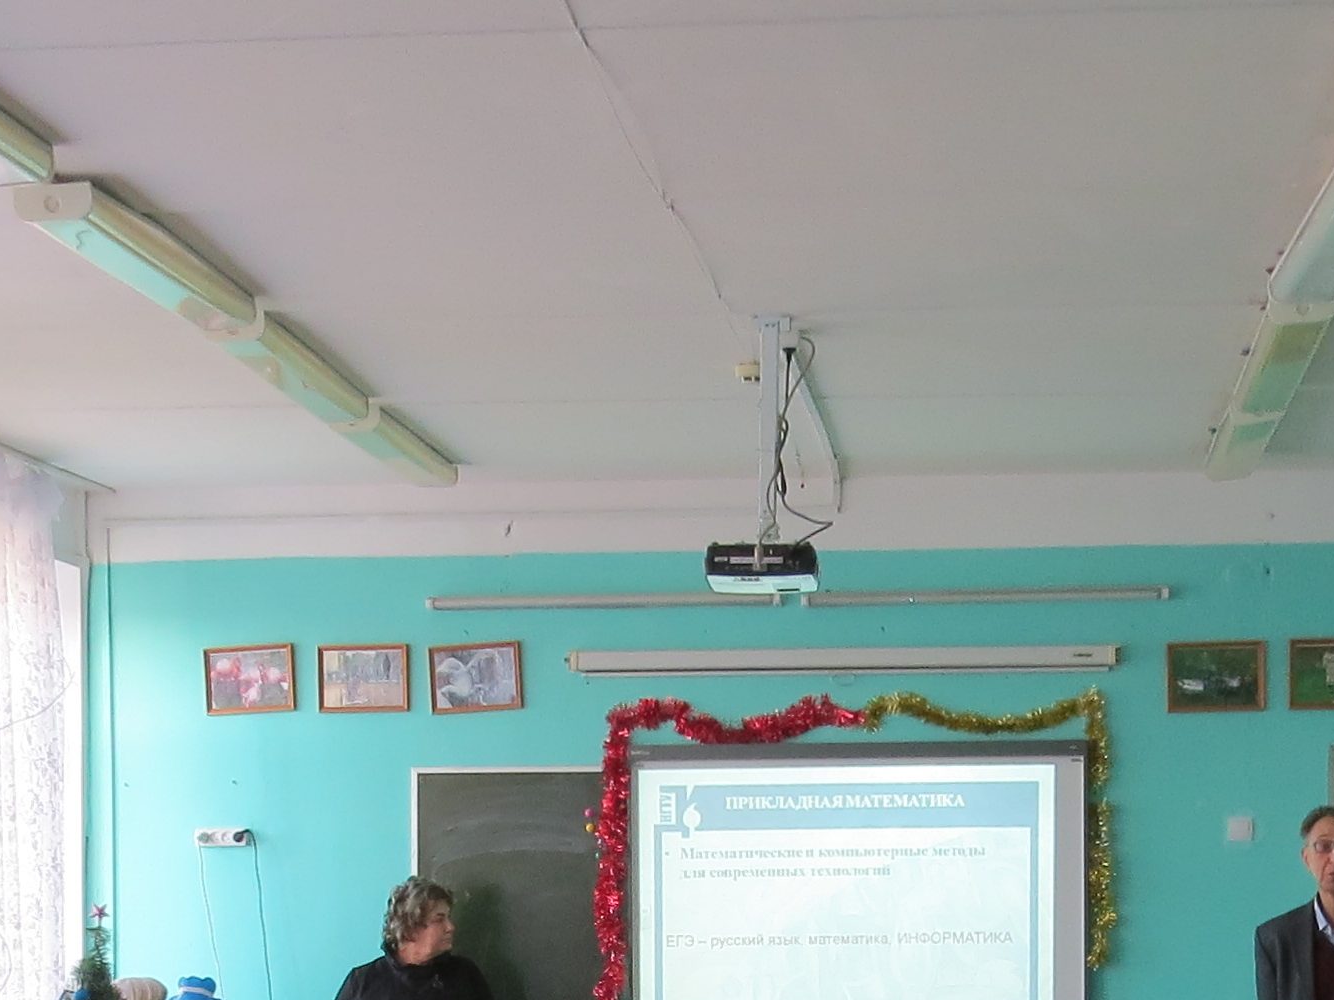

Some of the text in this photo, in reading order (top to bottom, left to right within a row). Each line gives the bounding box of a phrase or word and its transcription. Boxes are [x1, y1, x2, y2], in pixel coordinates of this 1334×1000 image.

[725, 793, 965, 811] ПРИКЛАДНАЯ МАТЕМАТИКА
[680, 846, 803, 860] Математические
[818, 847, 929, 860] компьютерные
[932, 844, 986, 858] методы
[680, 863, 892, 882] для современных технологий
[666, 934, 695, 948] ЕГЭ
[710, 934, 765, 949] русский
[808, 932, 892, 945] математика,
[897, 930, 1013, 945] ИНФОРМАТИКА
